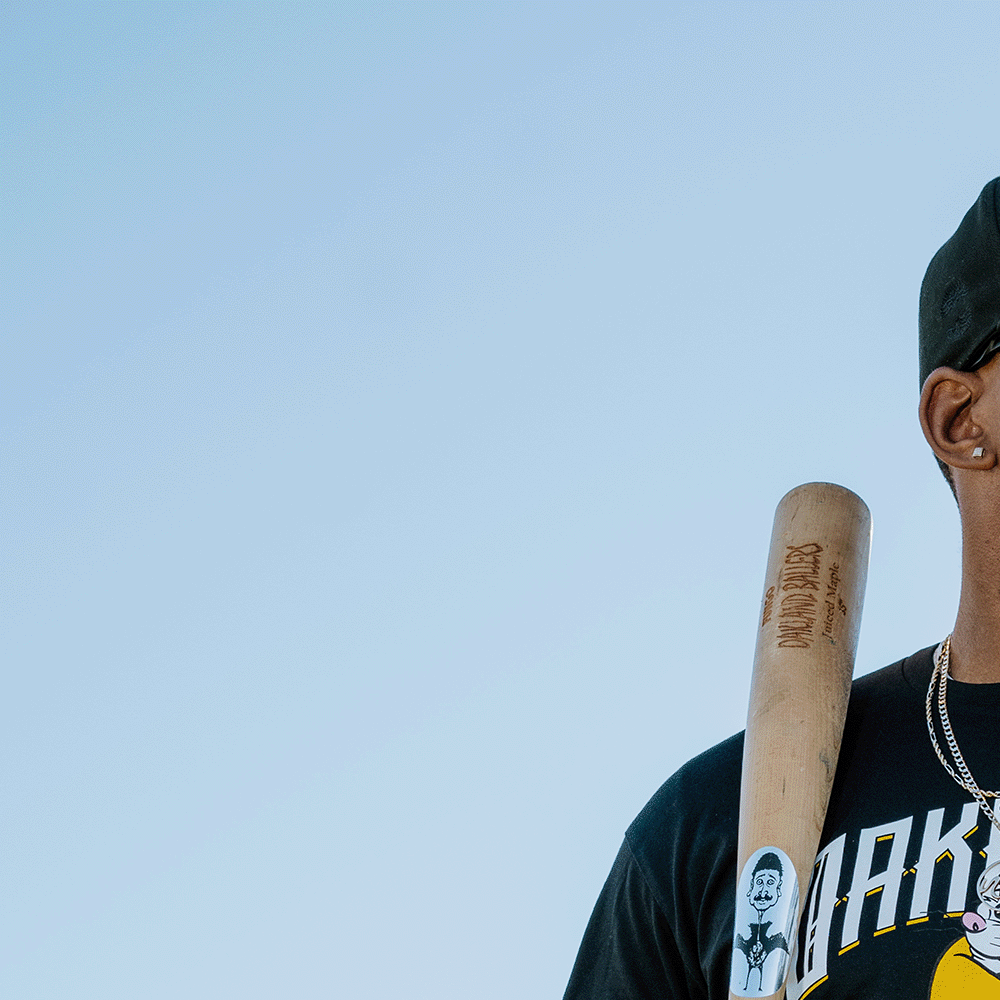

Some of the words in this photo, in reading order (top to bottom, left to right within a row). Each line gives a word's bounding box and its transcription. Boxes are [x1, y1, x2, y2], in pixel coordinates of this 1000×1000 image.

[783, 542, 823, 592] BALLERS
[826, 561, 841, 599] Maple
[776, 593, 818, 648] OAKLAND
[821, 600, 836, 644] Juiced
